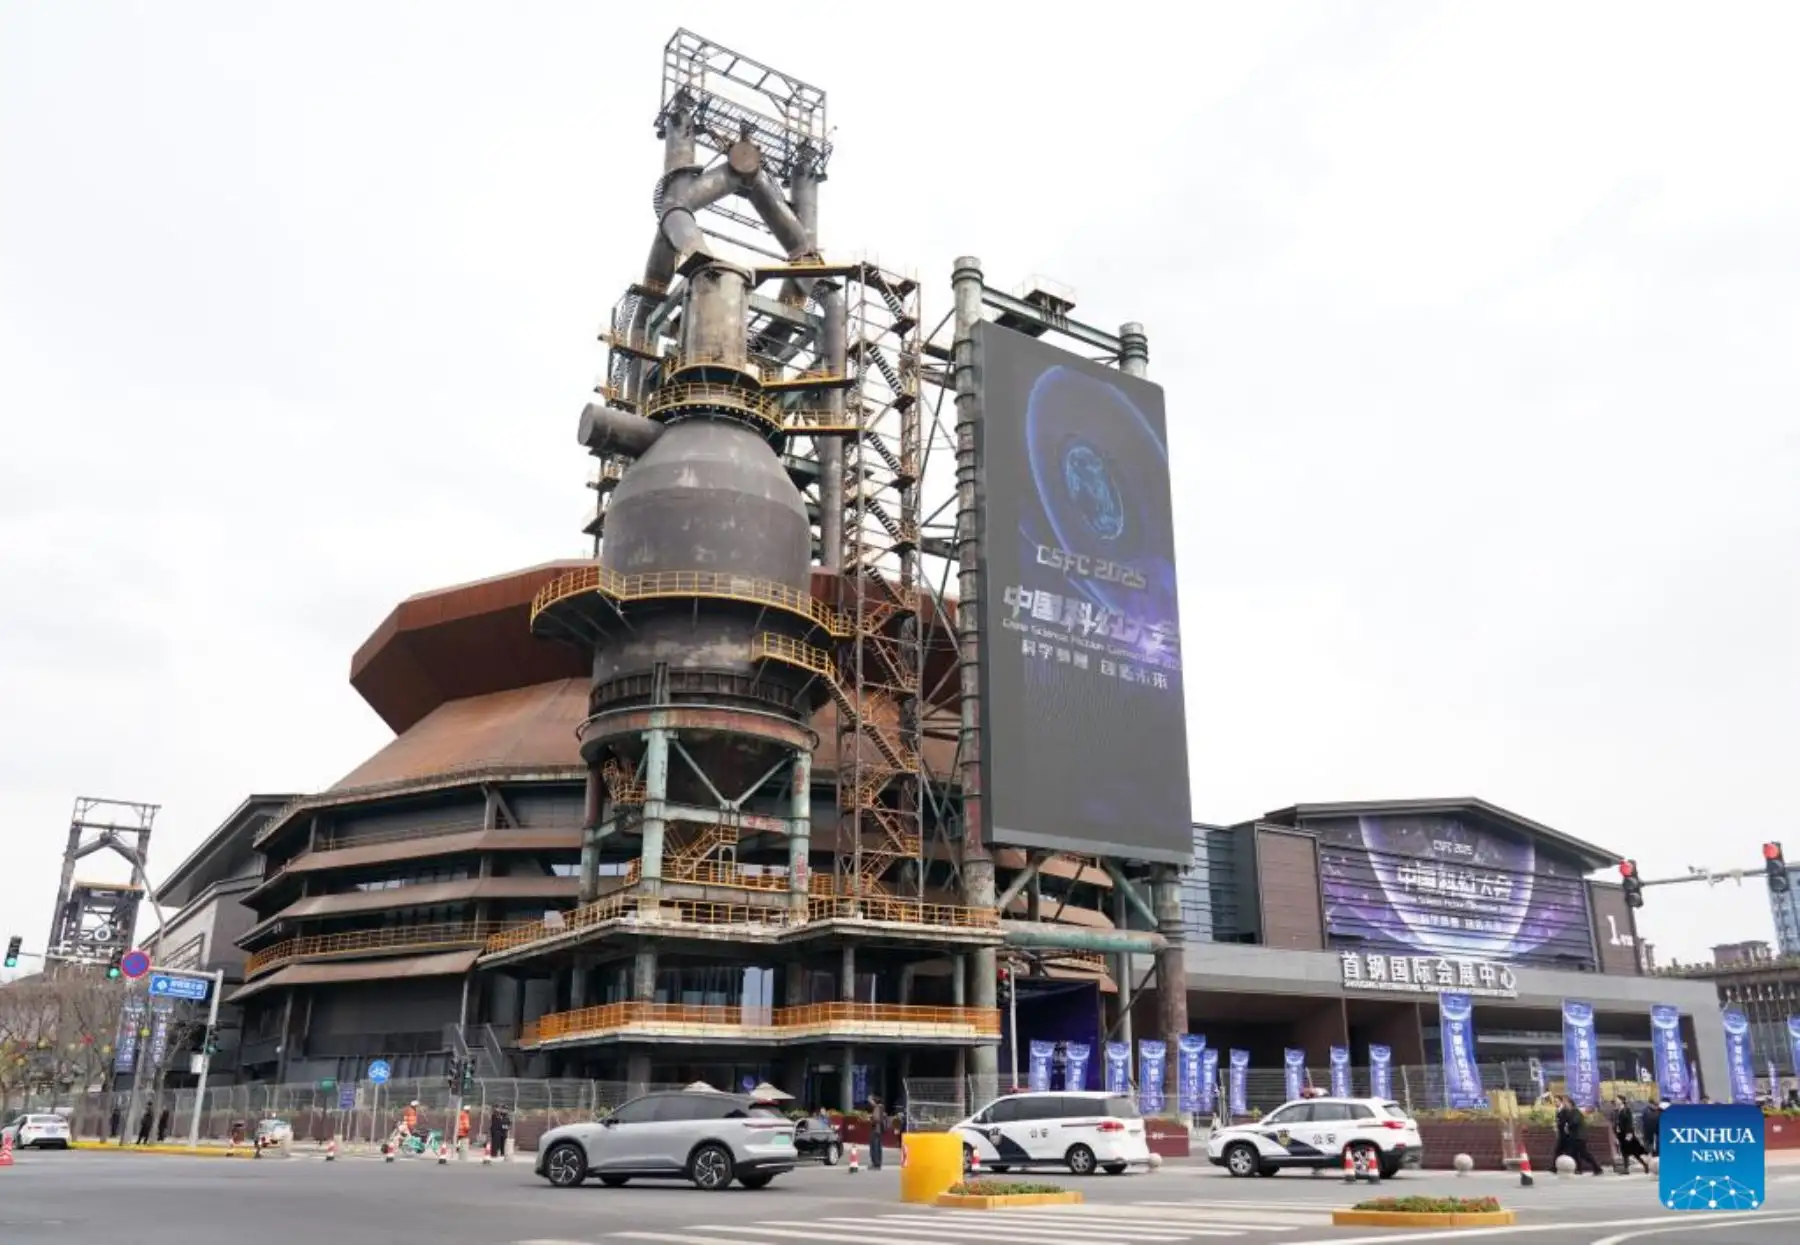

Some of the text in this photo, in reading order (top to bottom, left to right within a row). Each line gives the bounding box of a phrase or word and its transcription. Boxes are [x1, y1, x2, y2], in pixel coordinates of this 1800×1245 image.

[1036, 544, 1148, 589] CSFC 2025
[1340, 950, 1517, 989] 首钢国际会展中心
[1312, 1133, 1337, 1145] 公安
